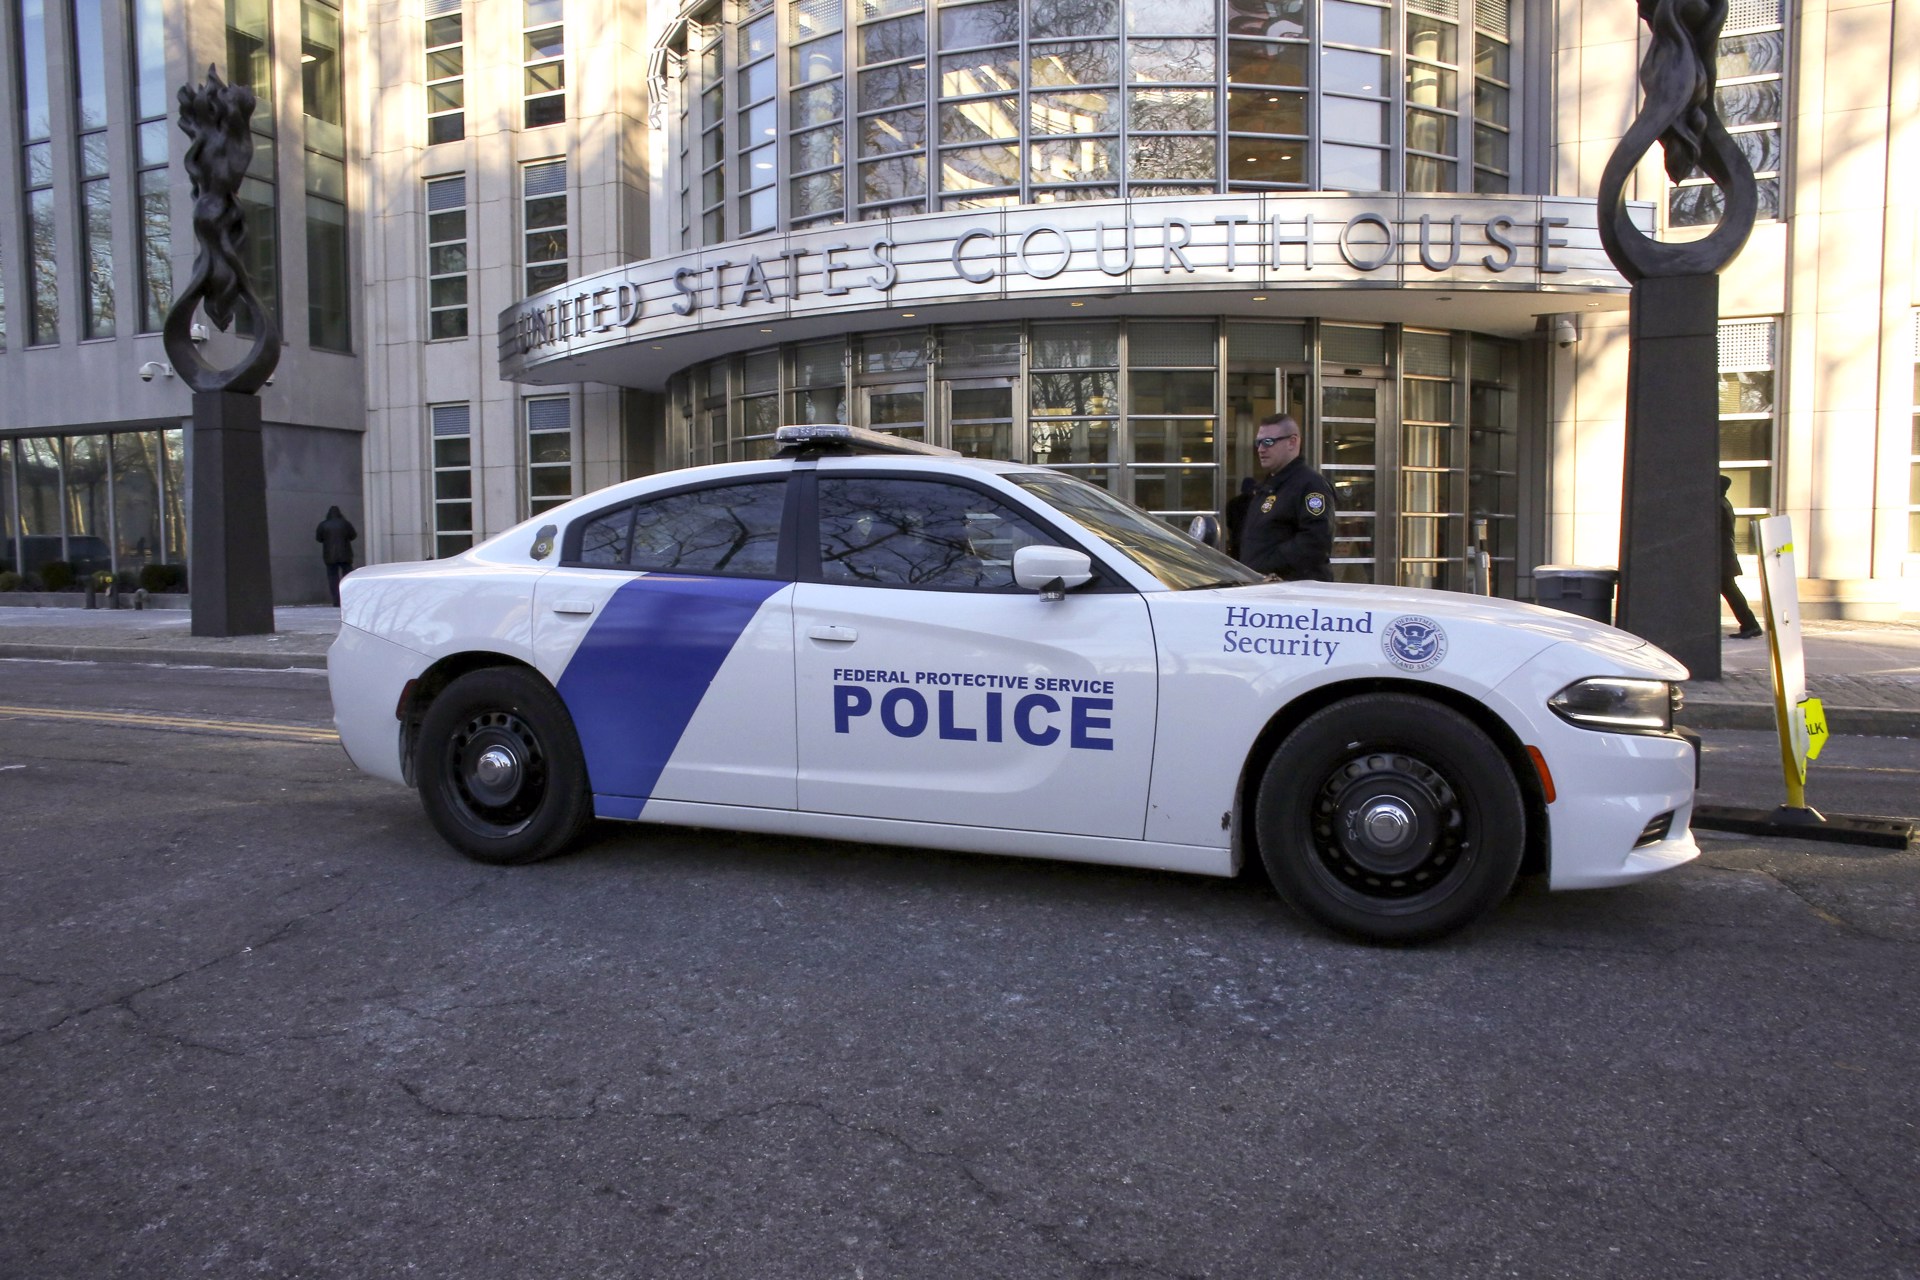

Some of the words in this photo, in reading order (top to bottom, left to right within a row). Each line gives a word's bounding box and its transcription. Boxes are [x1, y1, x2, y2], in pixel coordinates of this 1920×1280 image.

[515, 281, 638, 354] UNITED
[671, 236, 897, 316] STATES
[952, 212, 1569, 283] COURTHOUSE
[1224, 606, 1374, 634] Homeland
[1396, 617, 1440, 633] DEPARTMENT
[1223, 630, 1340, 665] Security
[1383, 642, 1415, 670] HOMELAND
[1417, 648, 1445, 670] SECURITY
[833, 668, 910, 684] FEDERAL
[915, 671, 1029, 690] PROTECTIVE
[1034, 677, 1115, 695] SERVICE
[833, 684, 1115, 751] POLICE
